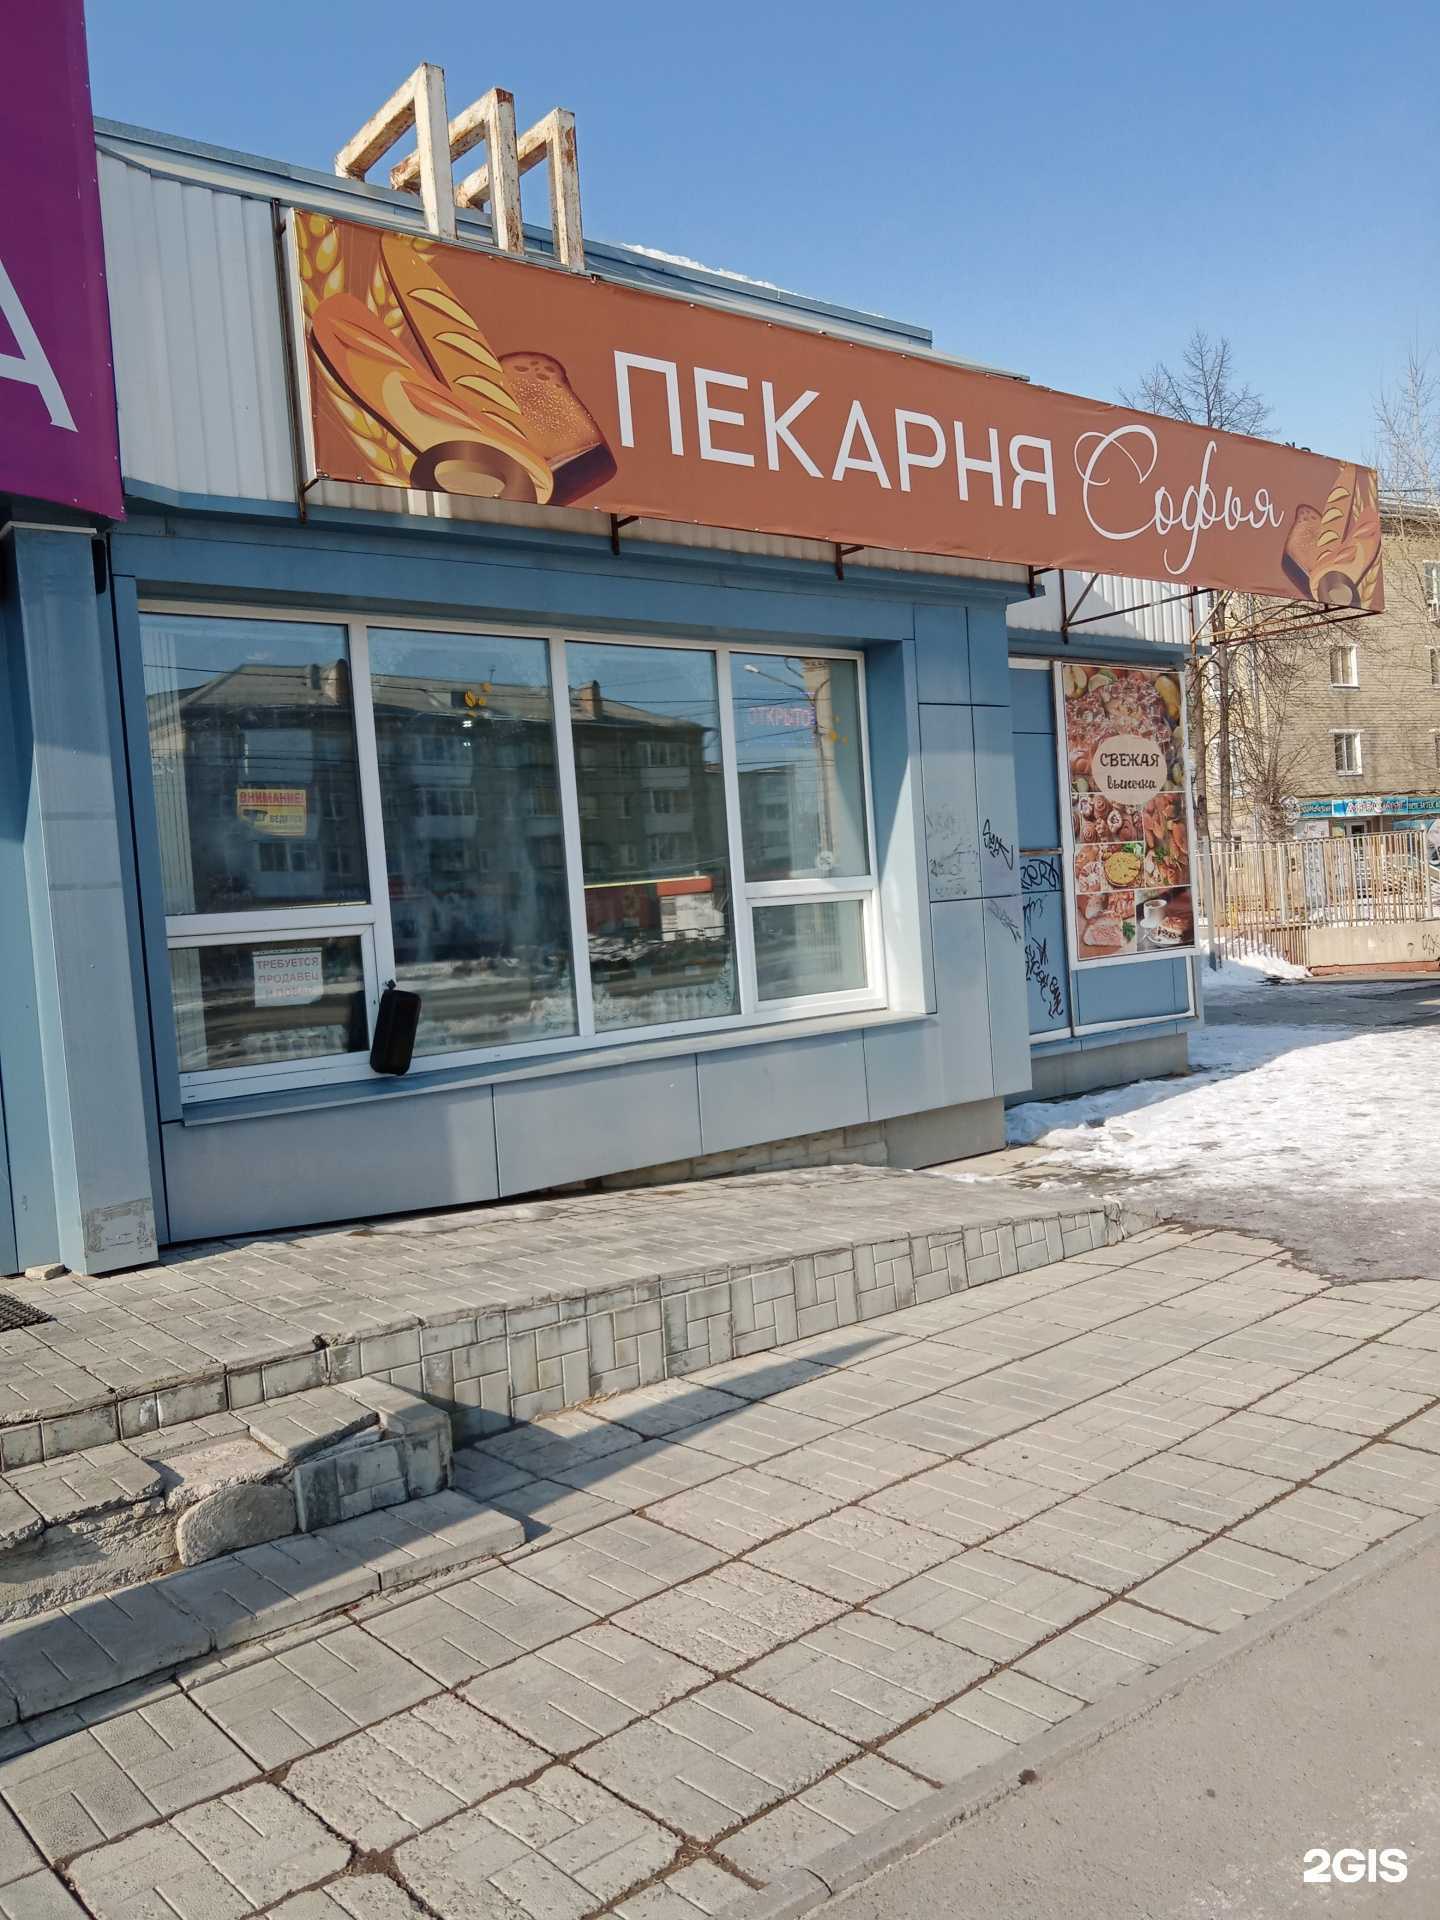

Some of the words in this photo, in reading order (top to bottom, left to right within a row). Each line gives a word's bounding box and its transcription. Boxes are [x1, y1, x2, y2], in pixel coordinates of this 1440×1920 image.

[613, 350, 1056, 516] ПЕКАРНЯ
[1073, 424, 1284, 575] Софья
[1100, 752, 1160, 768] СВЕЖАЯ
[256, 956, 319, 970] ТРЕБУЕТСЯ
[258, 971, 319, 984] ПРОДАВЕЦ
